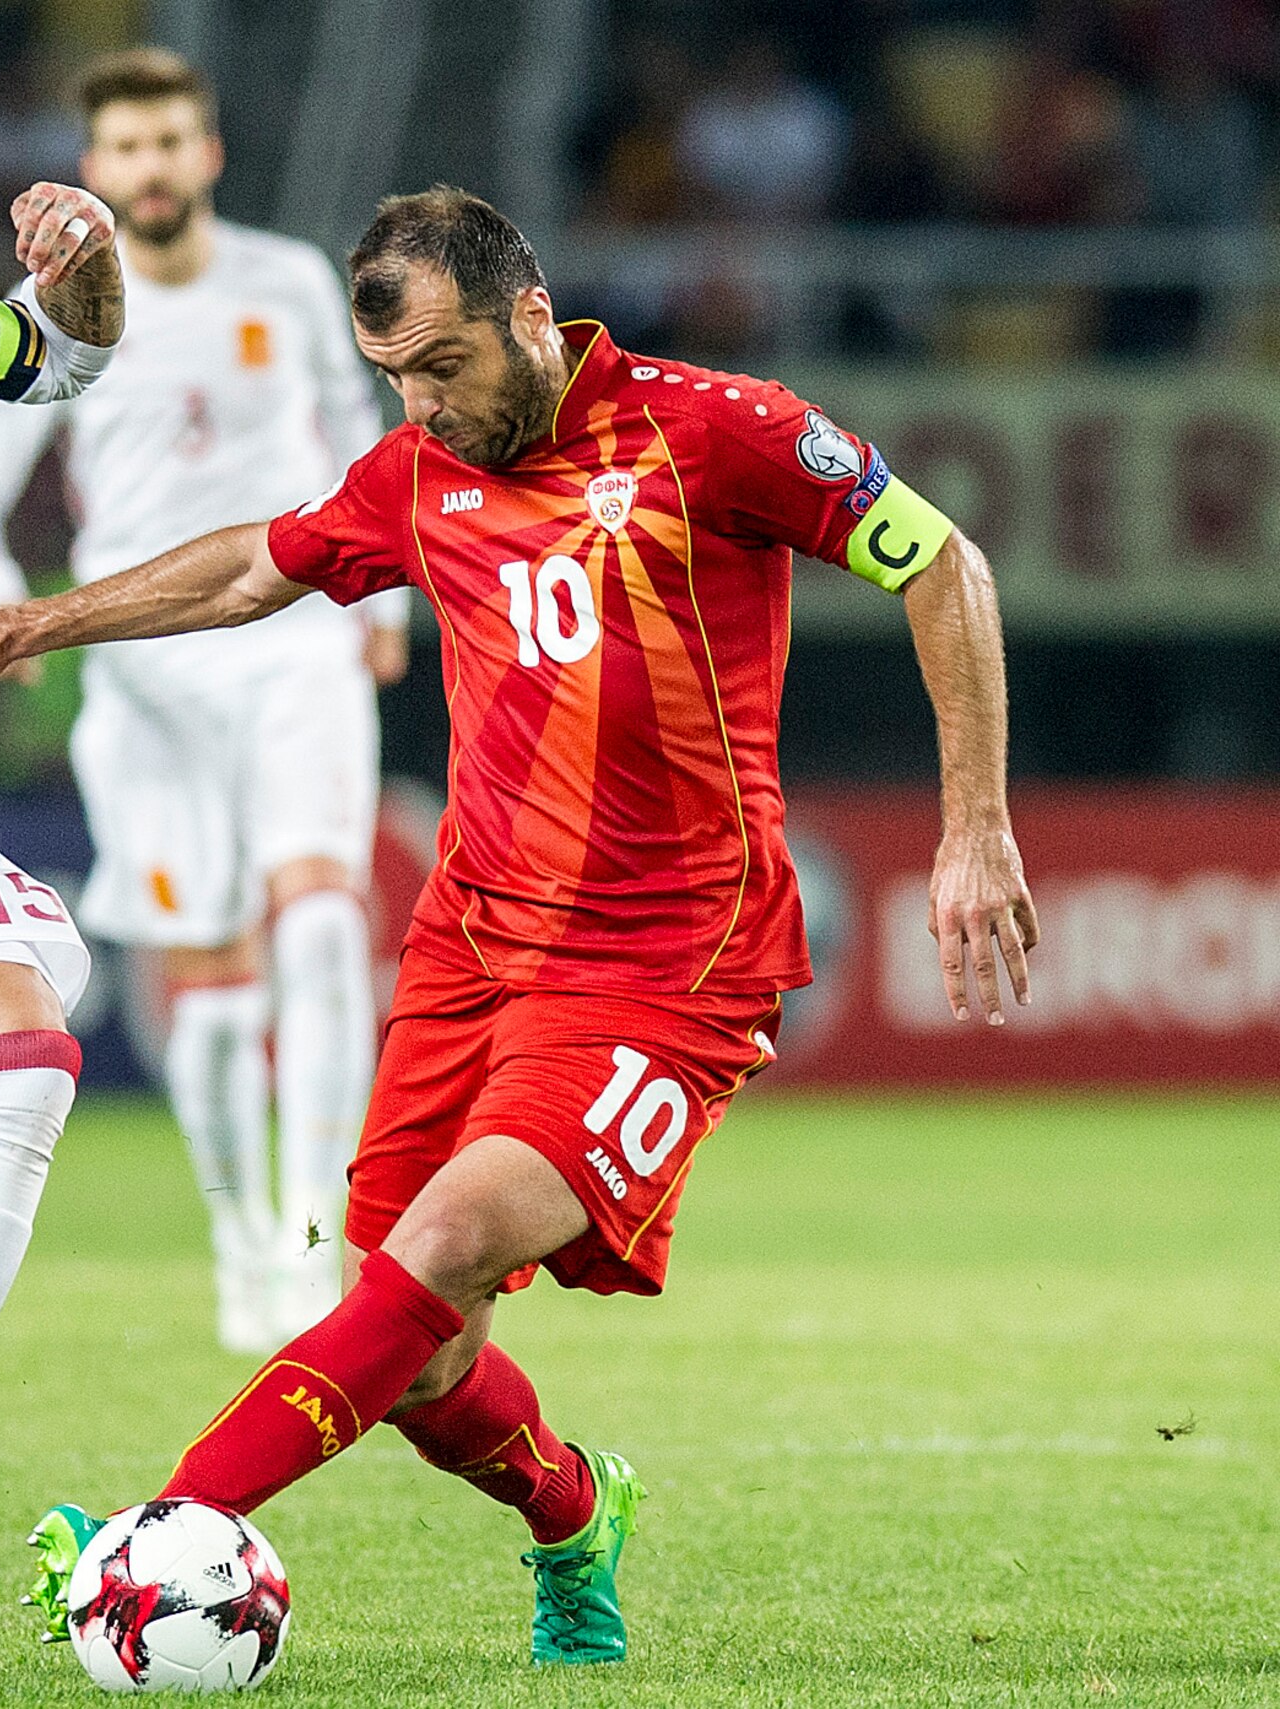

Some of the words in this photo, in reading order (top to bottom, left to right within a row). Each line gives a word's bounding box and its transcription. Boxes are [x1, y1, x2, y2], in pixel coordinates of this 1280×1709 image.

[441, 488, 483, 514] JAKO
[868, 519, 920, 570] C
[500, 554, 600, 668] 10
[583, 1045, 688, 1177] 10
[585, 1146, 628, 1200] JAKO
[280, 1385, 341, 1457] JAKO
[202, 1568, 236, 1589] adidas
